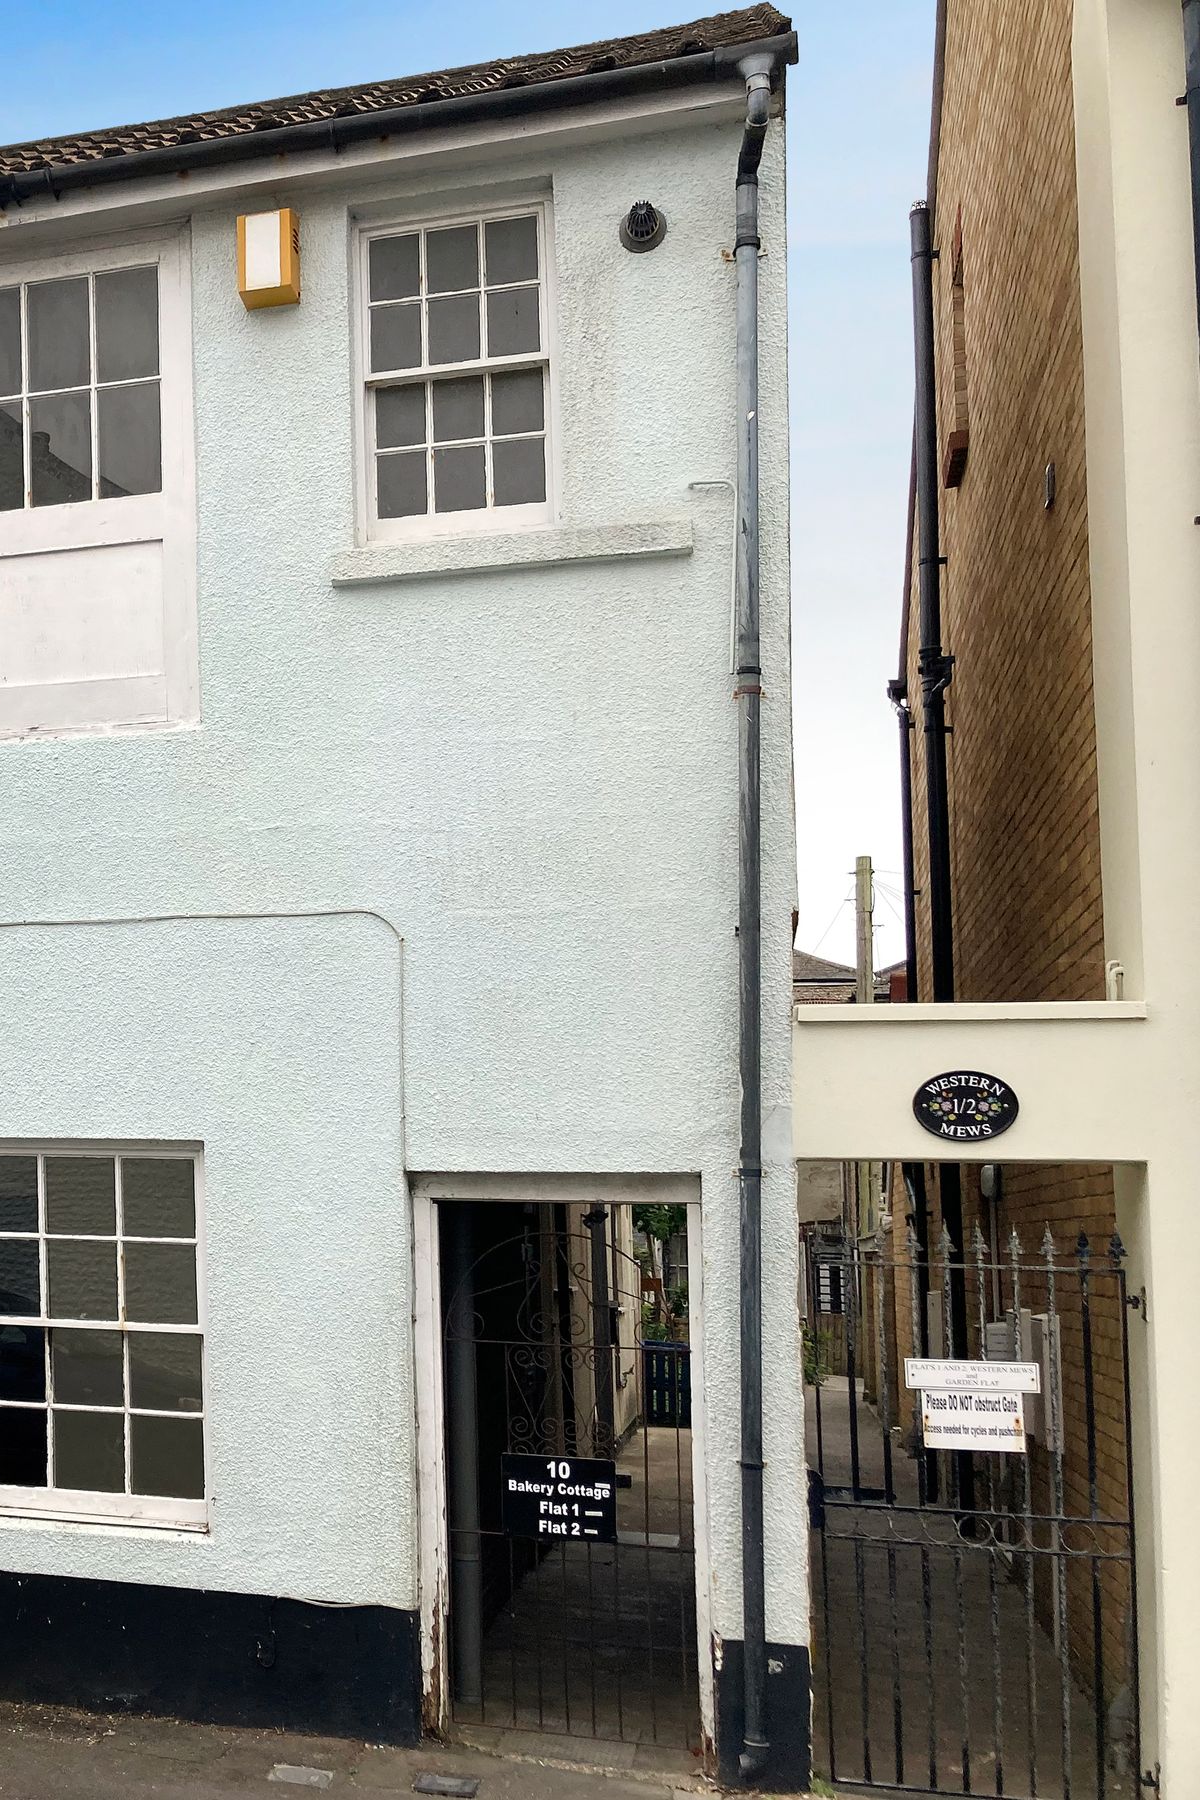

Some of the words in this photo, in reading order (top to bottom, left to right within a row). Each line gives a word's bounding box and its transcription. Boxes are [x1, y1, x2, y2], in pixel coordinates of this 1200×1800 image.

[925, 1075, 1005, 1097] WESTERN
[952, 1098, 976, 1114] 1/2
[940, 1123, 992, 1137] MEWS
[926, 1394, 947, 1410] Please
[948, 1394, 958, 1410] DO
[959, 1394, 972, 1410] NOT
[974, 1395, 1001, 1412] obstruct
[1002, 1396, 1018, 1412] Gate
[924, 1422, 942, 1434] Access
[943, 1424, 962, 1434] needed
[971, 1425, 987, 1438] cycles
[988, 1426, 998, 1436] and
[546, 1461, 570, 1479] 10
[508, 1479, 554, 1496] Bakery
[558, 1483, 610, 1500] Cottage
[540, 1501, 568, 1516] Flat
[572, 1504, 579, 1516] 1
[538, 1520, 568, 1535] Flat
[571, 1522, 580, 1536] 2
